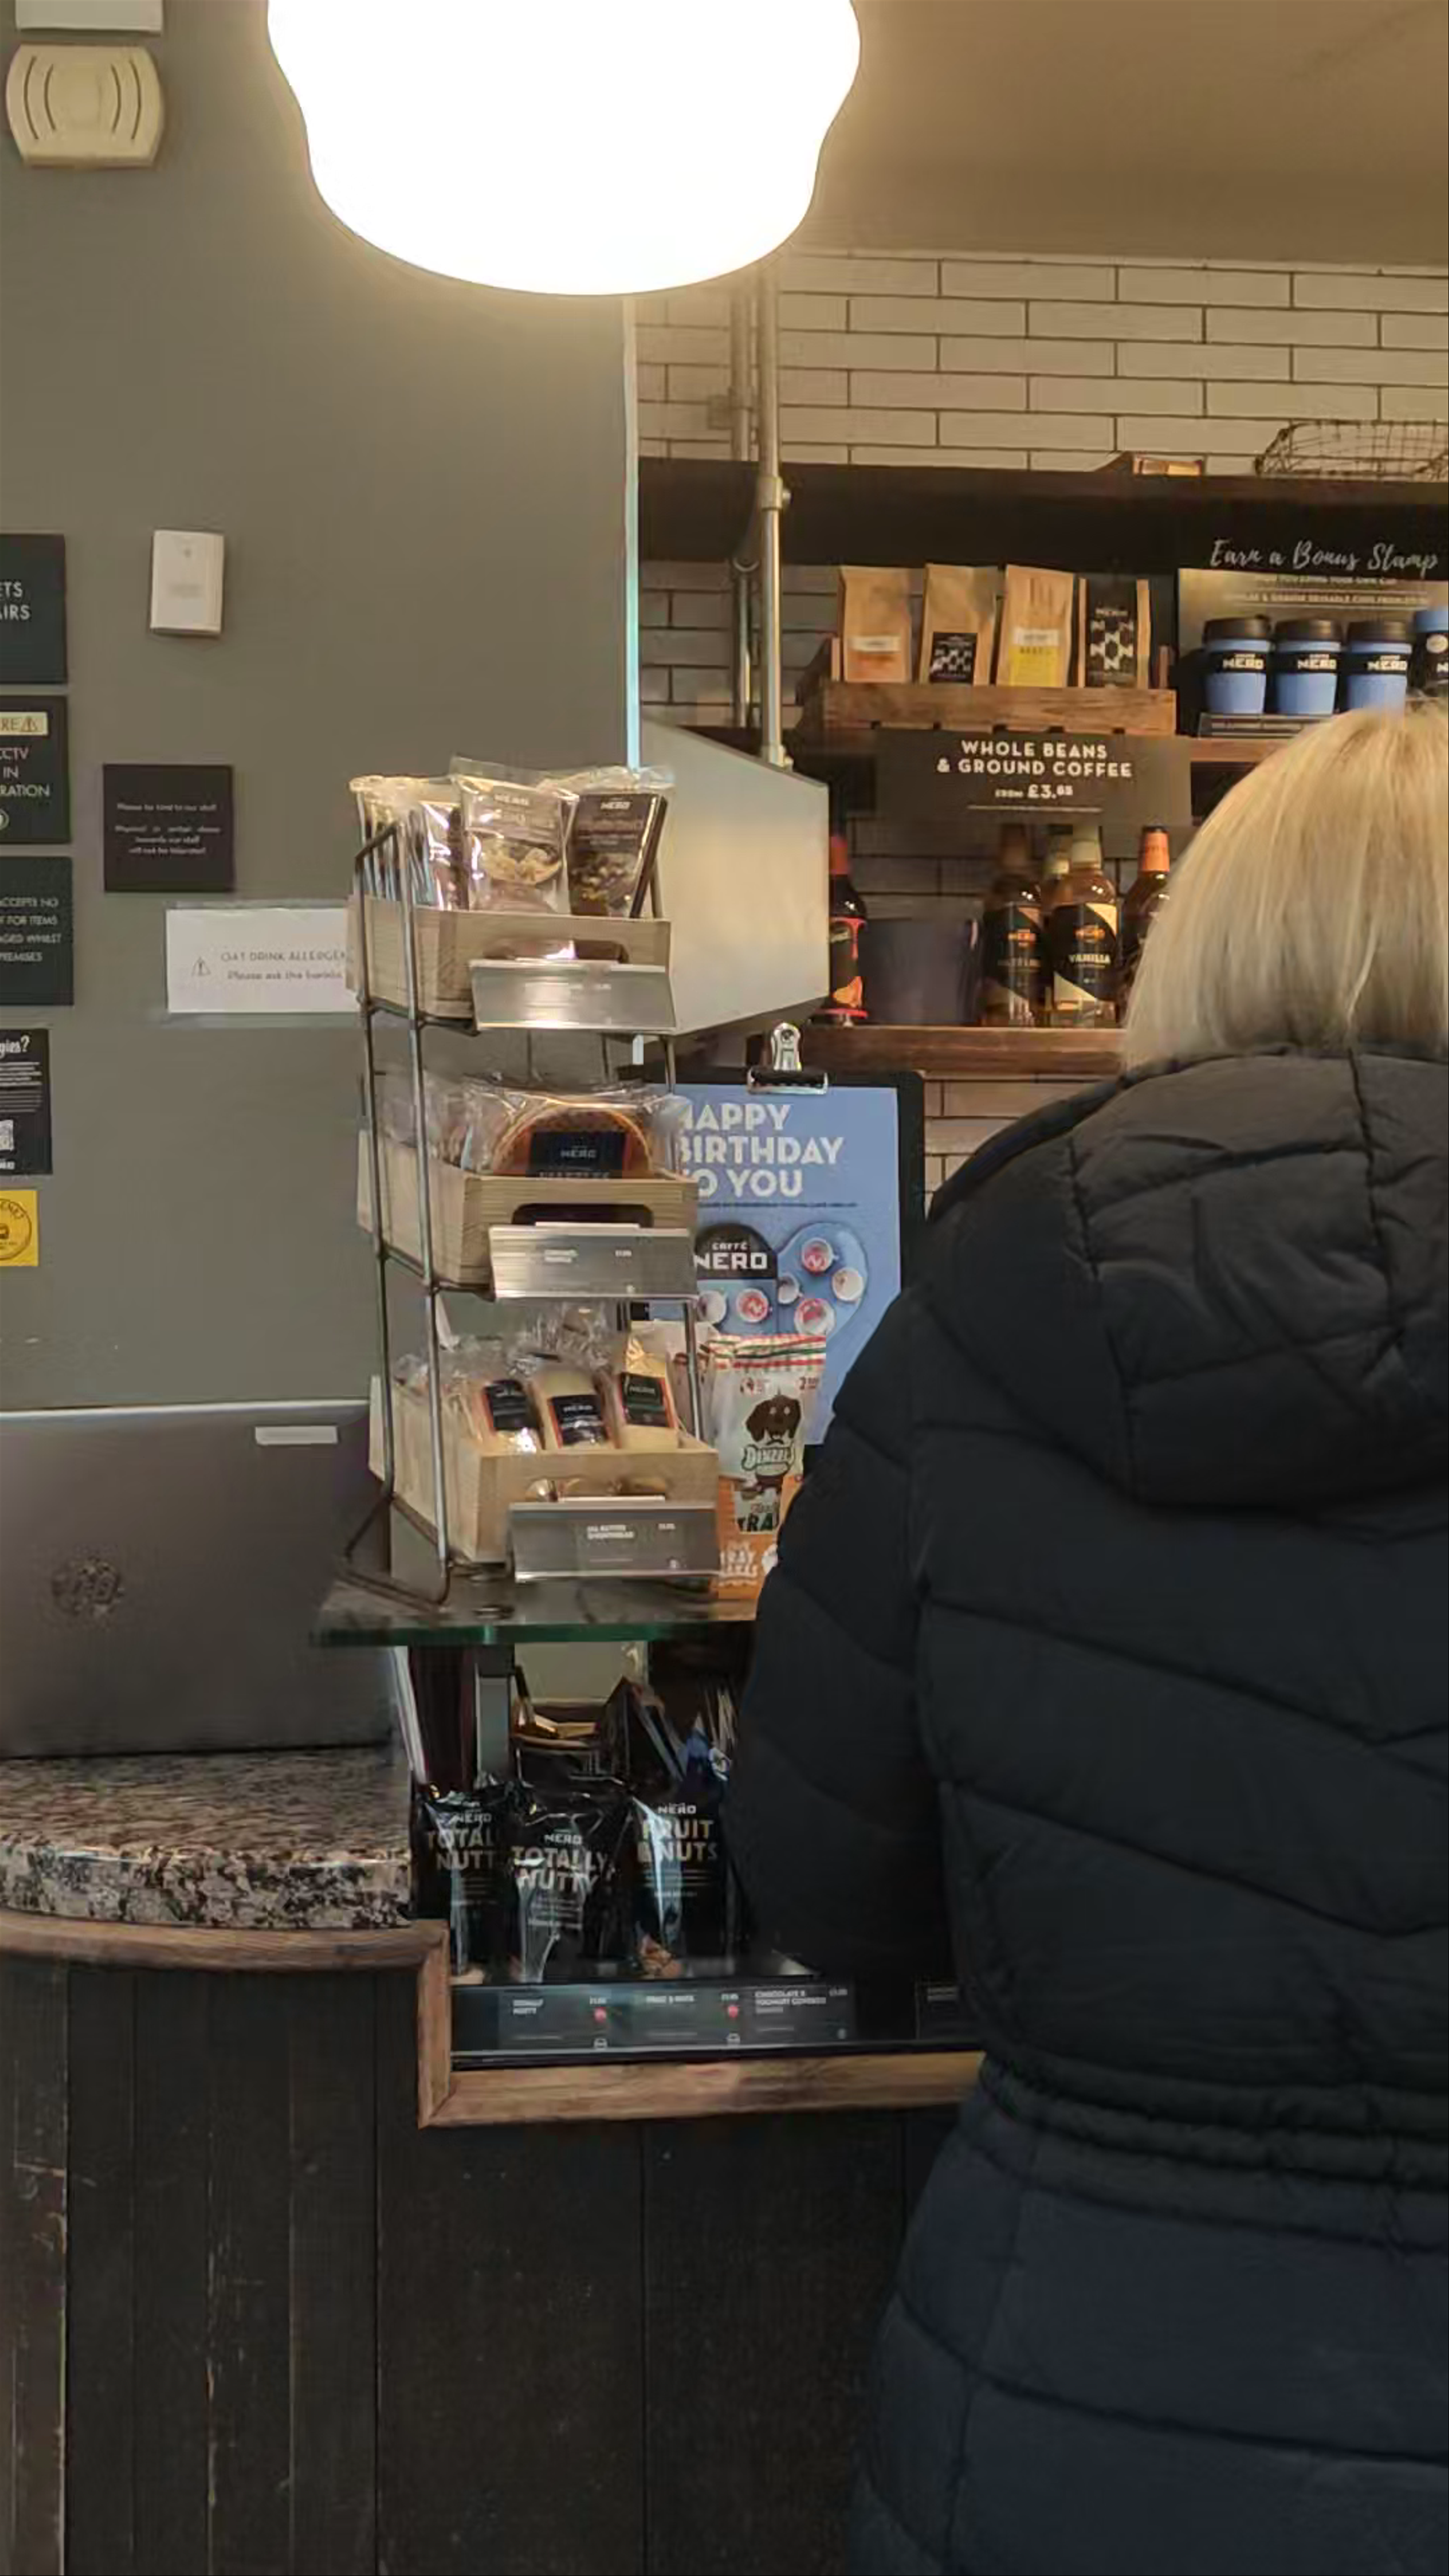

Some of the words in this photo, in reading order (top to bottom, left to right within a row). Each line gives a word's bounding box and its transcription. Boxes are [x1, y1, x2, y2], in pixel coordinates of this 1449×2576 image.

[1210, 539, 1263, 566] Earn
[1269, 549, 1285, 565] a
[1293, 540, 1360, 570] Bonus
[1367, 543, 1438, 579] Stamp
[0, 604, 30, 620] IRS
[962, 740, 1035, 757] WHOLE
[1043, 743, 1107, 759] BEANS
[3, 766, 18, 778] IN
[937, 758, 950, 773] &
[958, 759, 1045, 775] GROUND
[1053, 761, 1132, 777] COFFEE
[726, 1169, 803, 1198] YOU
[693, 1252, 768, 1270] NERO
[544, 1834, 583, 1845] NERO
